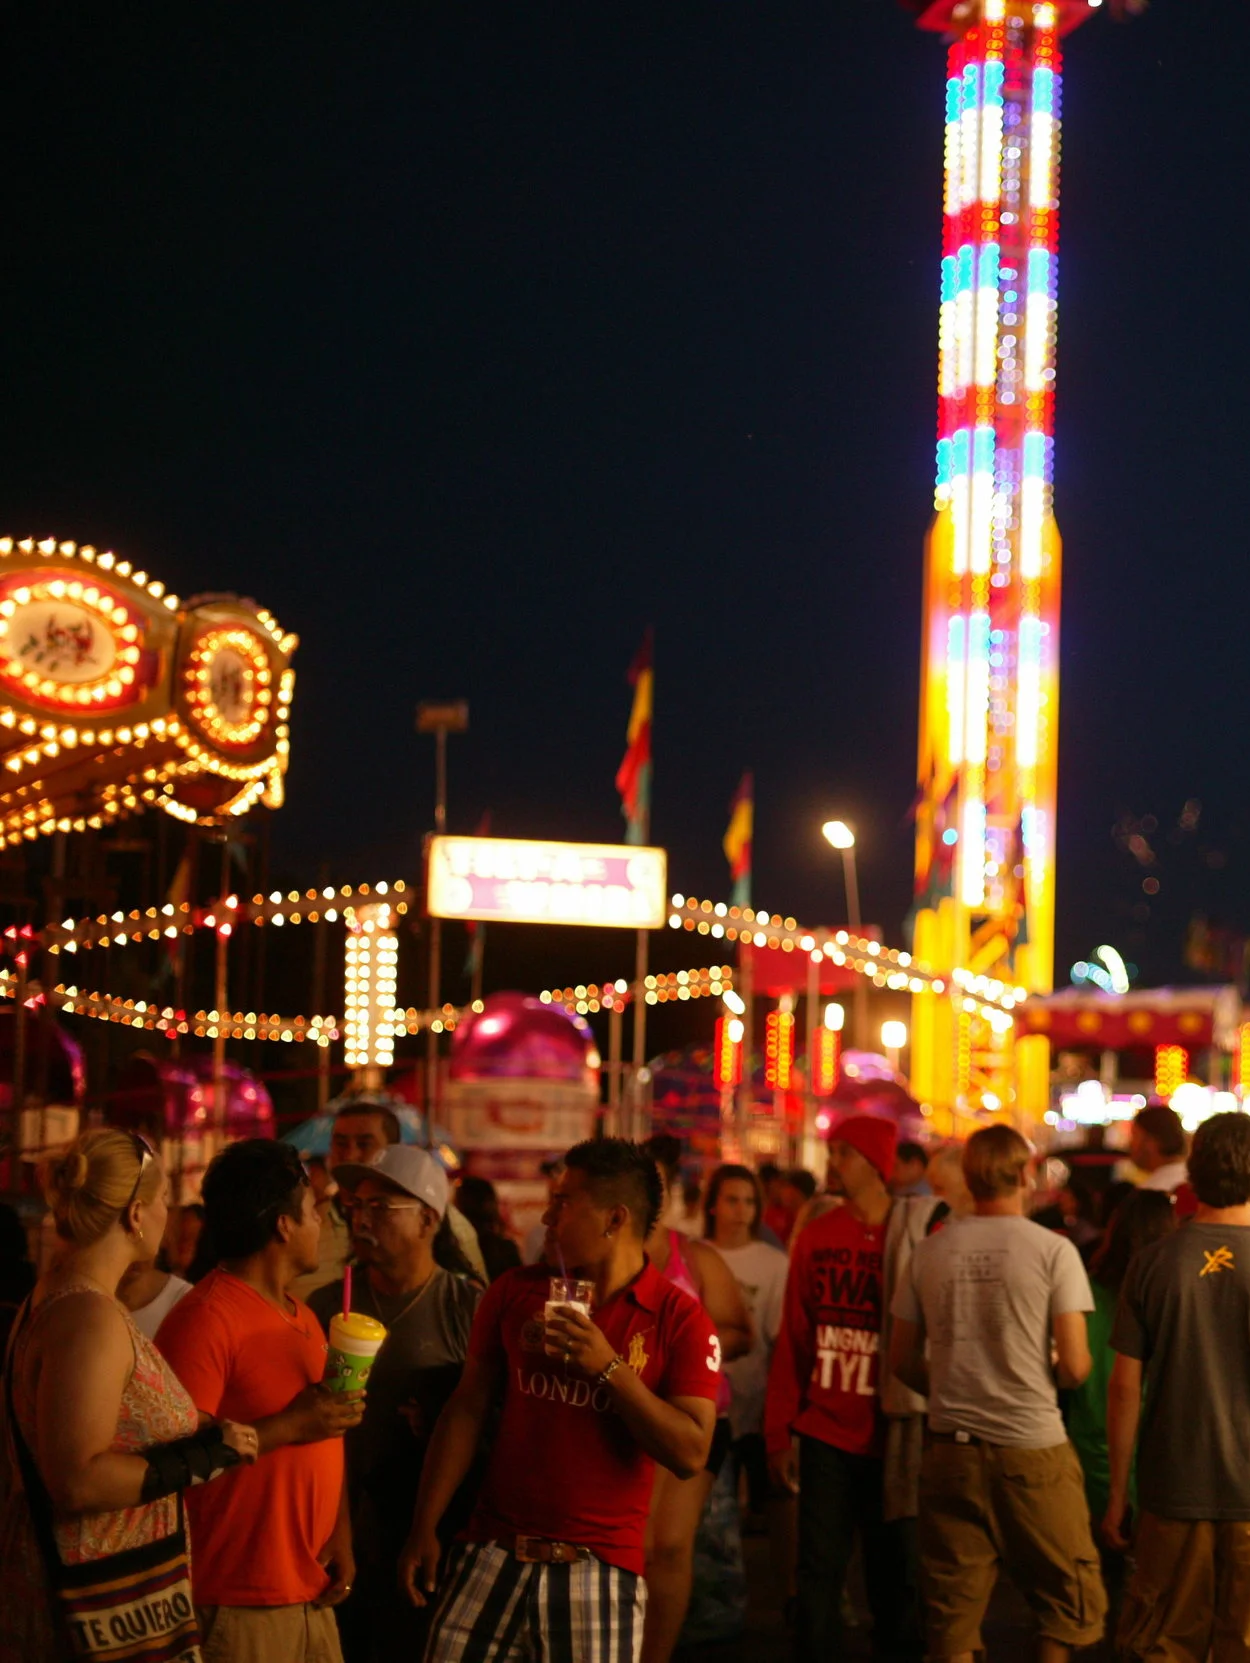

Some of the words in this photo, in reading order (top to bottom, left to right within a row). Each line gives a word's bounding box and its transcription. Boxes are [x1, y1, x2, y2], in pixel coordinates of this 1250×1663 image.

[705, 1334, 722, 1373] 3
[811, 1349, 877, 1396] TYL
[516, 1367, 619, 1414] LONDO
[109, 1591, 192, 1642] QUIERO
